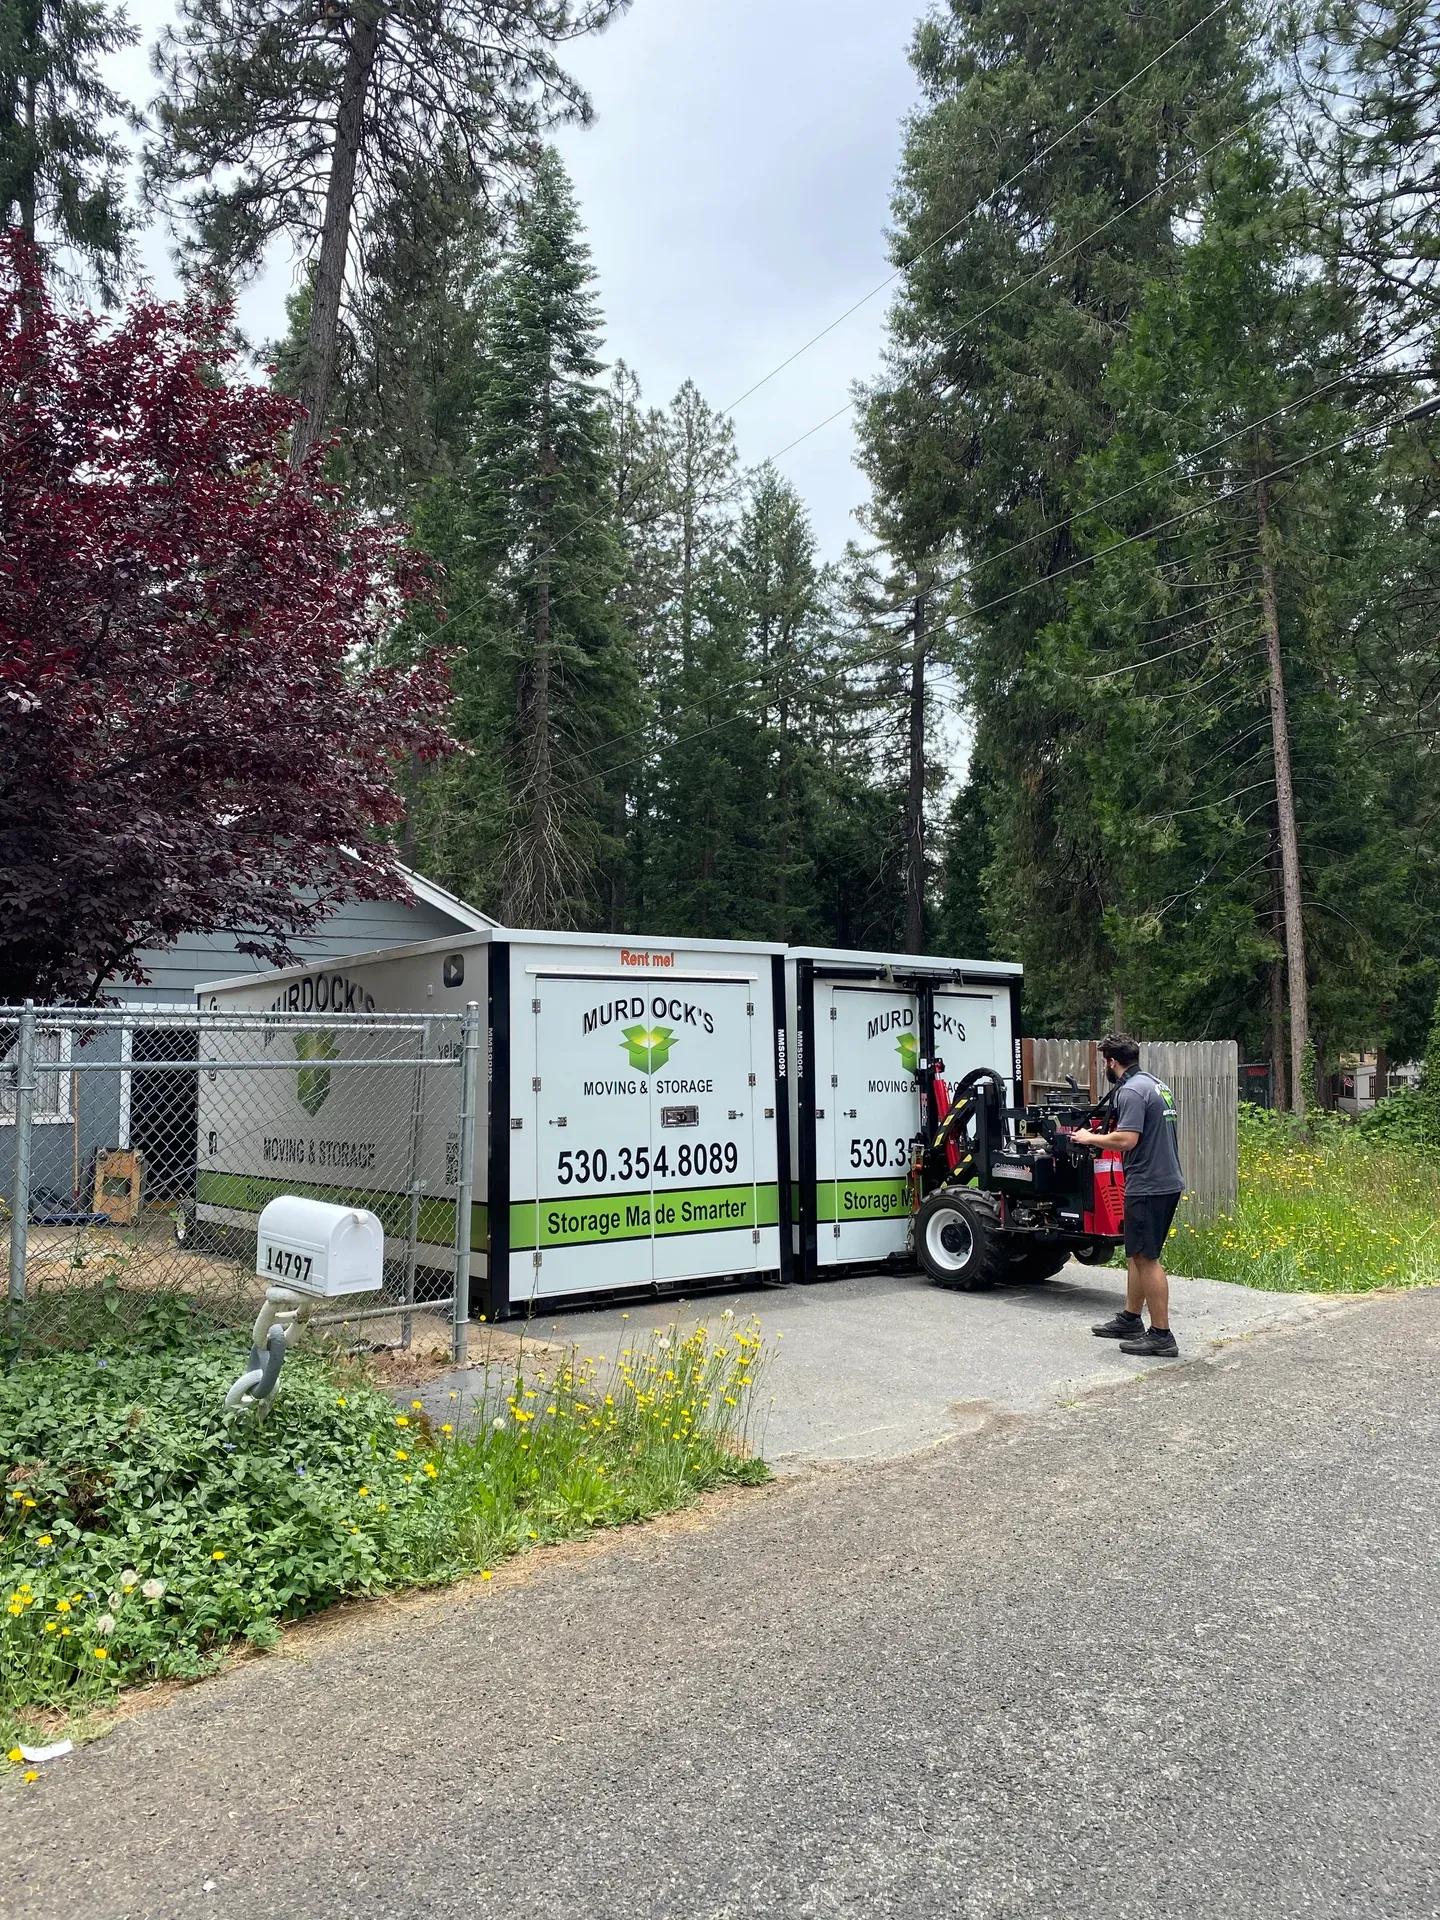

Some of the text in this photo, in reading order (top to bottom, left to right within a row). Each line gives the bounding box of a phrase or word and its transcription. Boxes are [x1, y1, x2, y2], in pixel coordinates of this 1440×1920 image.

[620, 950, 675, 968] Rent me!
[868, 1008, 966, 1041] MURDCK'S
[778, 1029, 786, 1078] MMS009X
[583, 1079, 714, 1096] MOVING & STORAGE
[868, 1080, 908, 1093] MOVING
[557, 1141, 738, 1185] 530.354.8089
[547, 1199, 747, 1235] Storage Made Smarter
[844, 1191, 898, 1213] Storage
[266, 1247, 313, 1281] 14797
